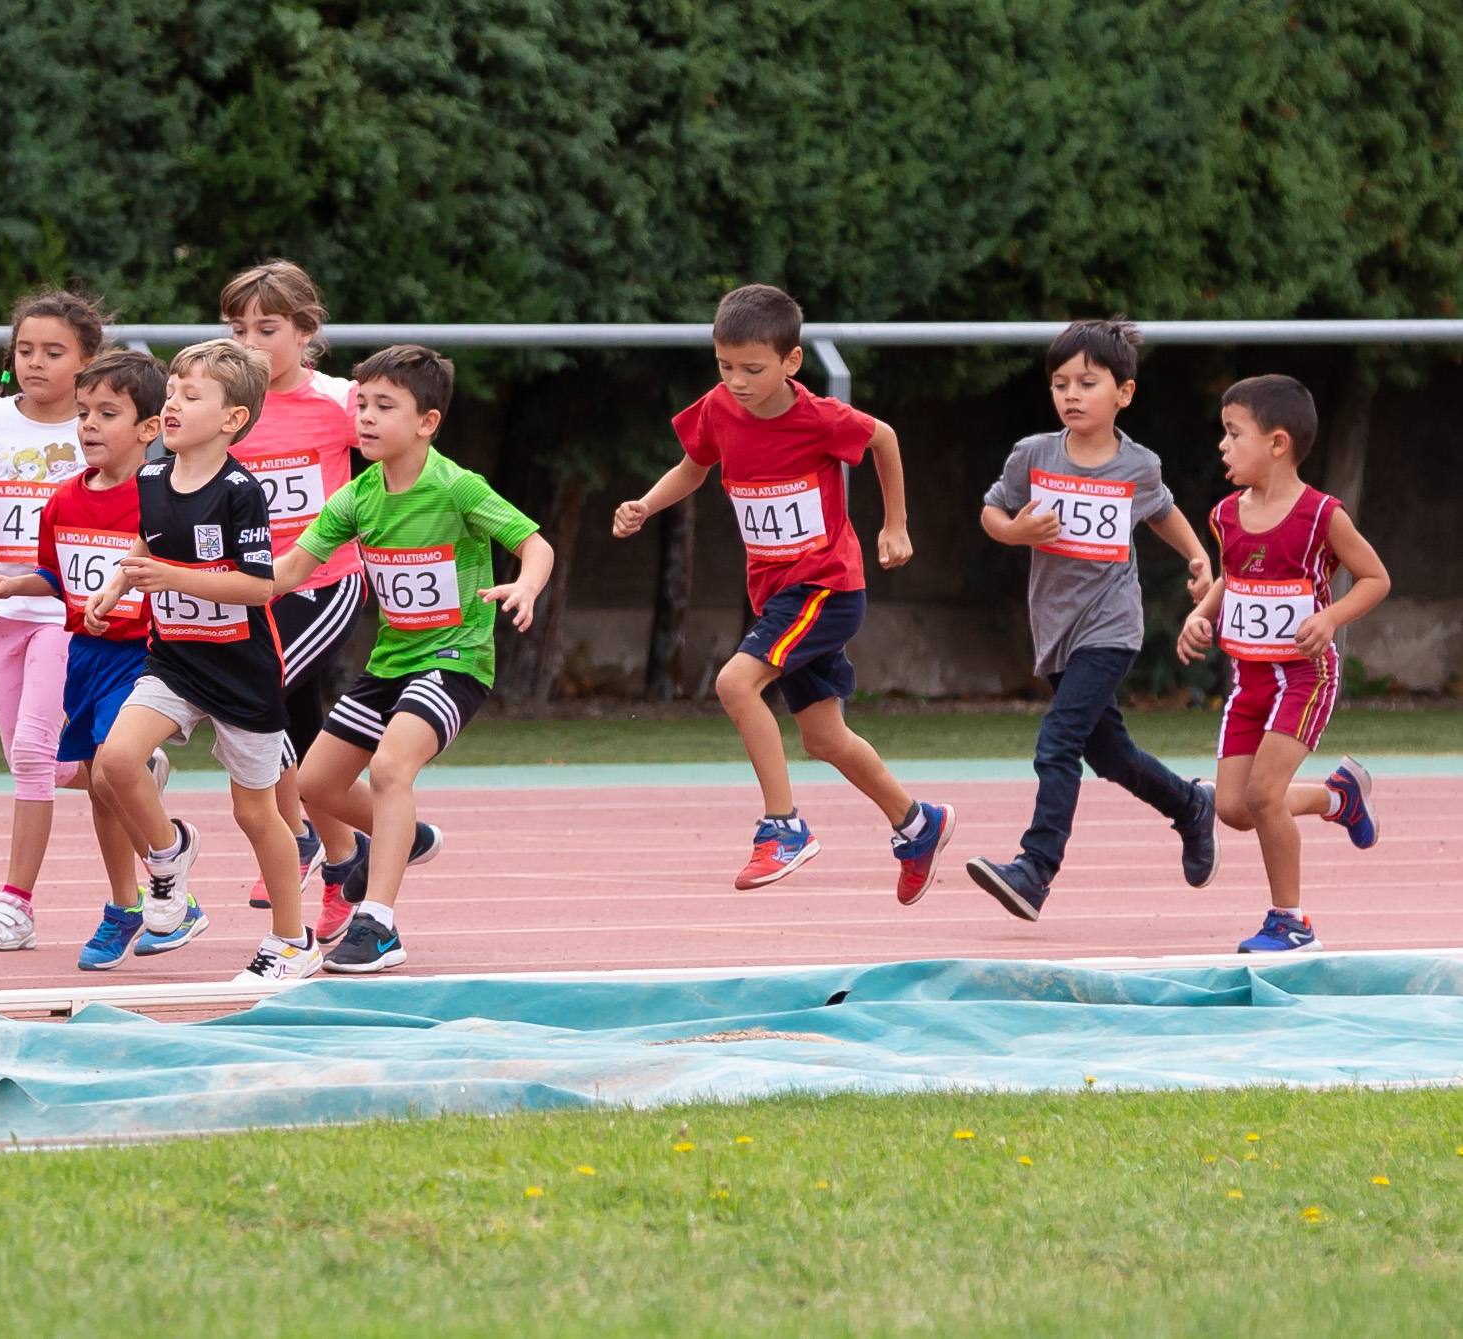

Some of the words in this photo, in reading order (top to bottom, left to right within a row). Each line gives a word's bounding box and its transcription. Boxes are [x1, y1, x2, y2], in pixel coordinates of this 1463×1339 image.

[261, 456, 310, 469] ATLETISMO
[4, 486, 34, 496] RIOJA
[758, 481, 807, 496] ATLETISMO
[1039, 477, 1047, 485] LA
[1049, 479, 1076, 491] RIOJA
[1079, 482, 1126, 496] ATLETISMO
[744, 502, 809, 540] 441
[58, 532, 66, 542] LA
[66, 533, 90, 545] RIOJA
[392, 550, 442, 563] ATLETISMO
[68, 553, 126, 592] 46
[377, 571, 441, 609] 463
[1252, 584, 1302, 595] ATLETISMO
[157, 589, 230, 620] 451
[1230, 602, 1296, 639] 432
